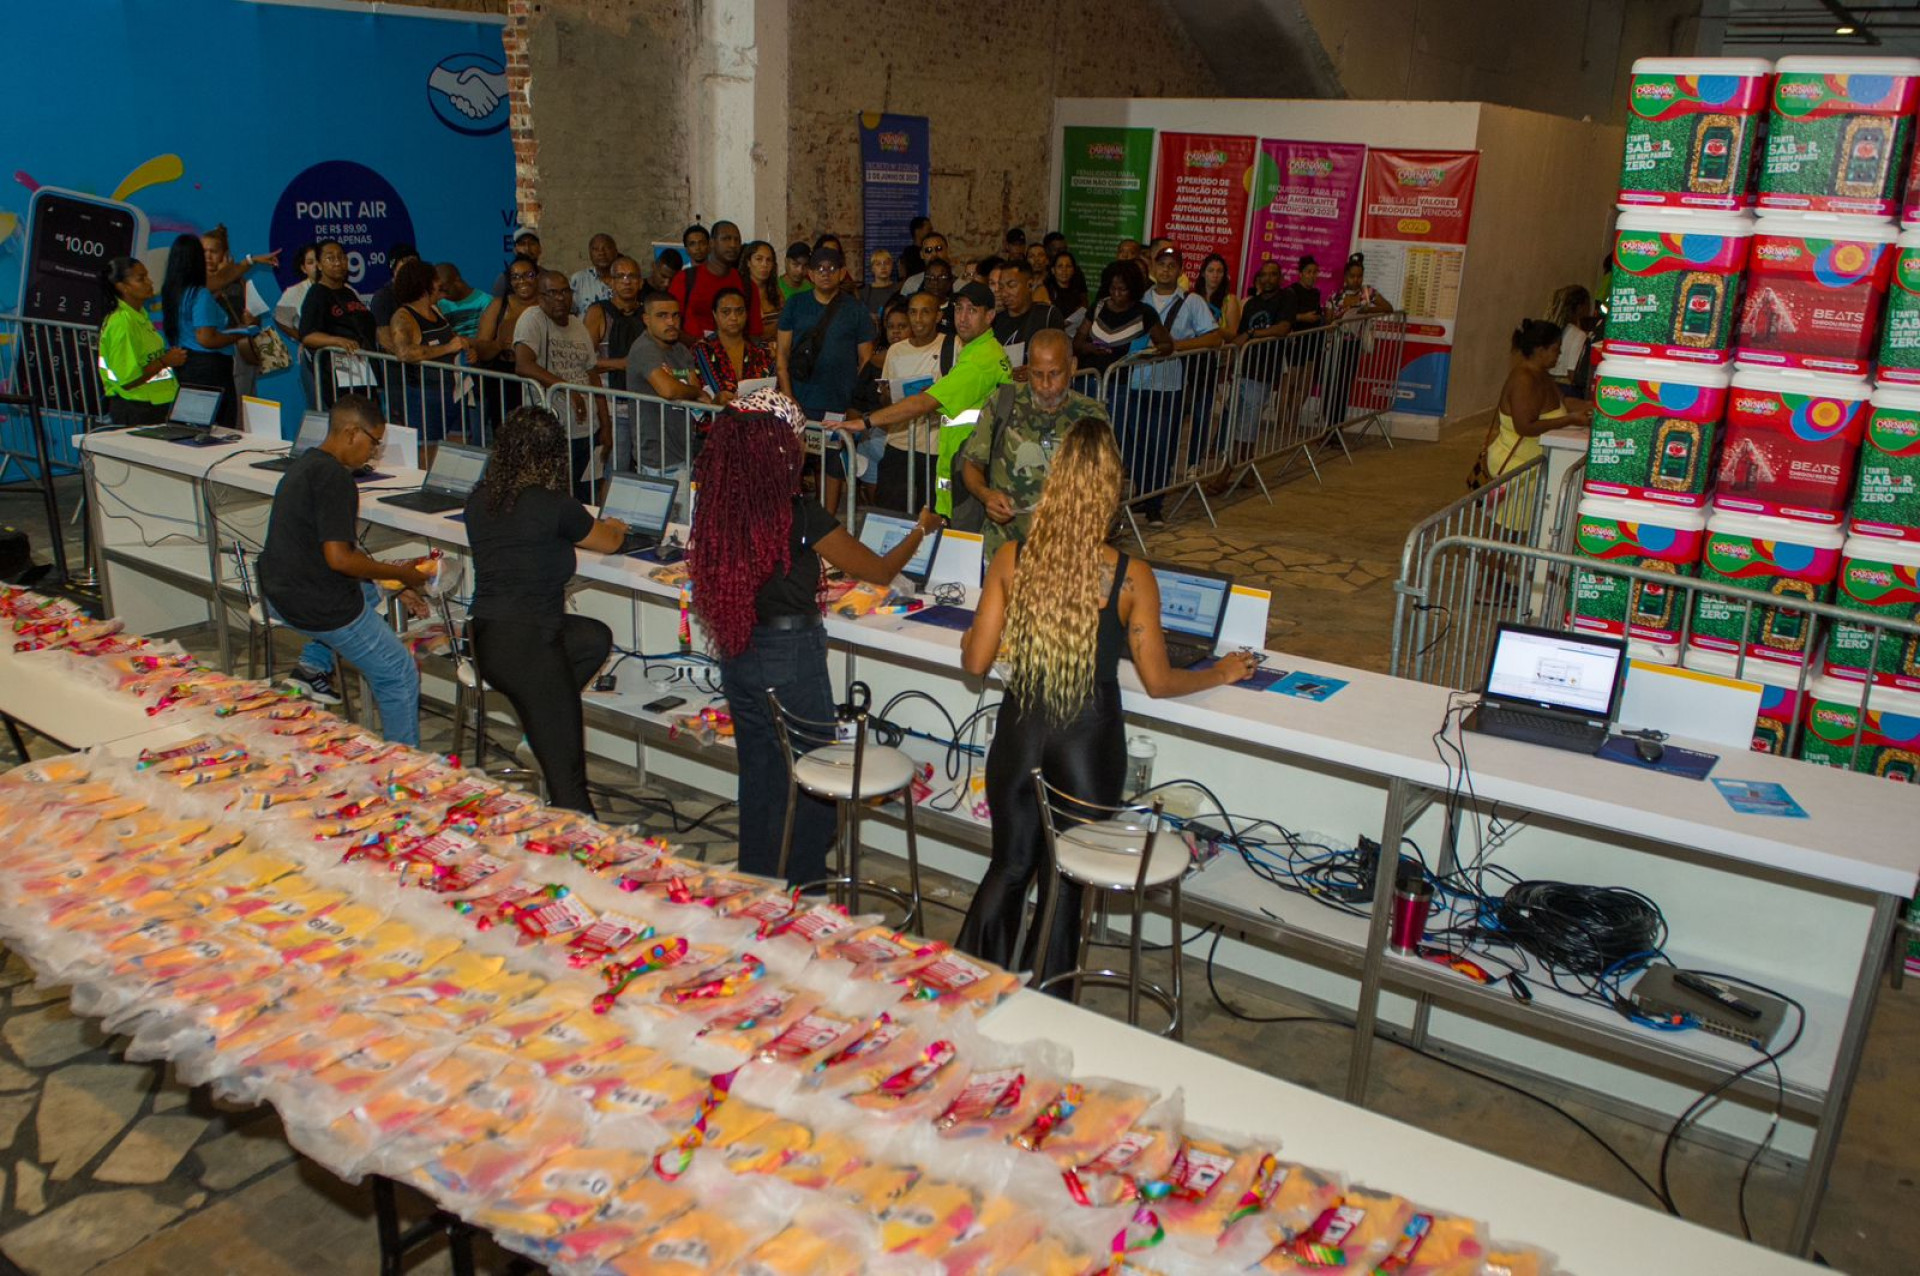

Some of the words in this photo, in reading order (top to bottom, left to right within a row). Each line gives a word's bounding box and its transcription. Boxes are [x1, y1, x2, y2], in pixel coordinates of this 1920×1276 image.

[1625, 159, 1656, 171] ZERO
[1767, 162, 1800, 173] ZERO
[1398, 167, 1441, 180] CARNAVAL
[1184, 175, 1218, 186] PERÍODO
[1176, 185, 1210, 196] ATUAÇÃO
[1212, 188, 1229, 196] DOS
[1268, 184, 1309, 194] REQUISITOS
[1310, 187, 1330, 196] PARA
[1332, 189, 1346, 198] SER
[1176, 195, 1226, 205] AMBULANTES
[1289, 196, 1335, 206] AMBULANTE
[1419, 197, 1456, 206] VALORES
[296, 201, 353, 219] POINT
[358, 201, 387, 218] AIR
[1173, 204, 1221, 214] AUTÔNOMOS
[1271, 204, 1315, 214] AUTÔNOMO
[1377, 206, 1420, 215] PRODUTOS
[1423, 208, 1463, 218] VENDIDOS
[1171, 214, 1215, 224] TRABALHAR
[315, 225, 328, 234] DE
[330, 224, 342, 234] R$
[1165, 222, 1204, 232] CARNAVAL
[1217, 226, 1232, 235] RUA
[337, 235, 372, 244] APENAS
[1177, 233, 1215, 242] RESTRINGE
[1217, 236, 1229, 244] AO
[65, 236, 104, 257] 10,00
[1180, 242, 1213, 252] HORÁRIO
[1757, 244, 1799, 256] CARNAVAL
[59, 296, 66, 307] 2
[83, 301, 91, 312] 3
[1611, 312, 1641, 323] ZERO
[1813, 308, 1865, 322] BEATS
[1736, 398, 1776, 412] CARNAVAL
[1876, 419, 1918, 430] CARNAVAL
[1591, 455, 1621, 464] ZERO
[1791, 460, 1841, 475] BEATS
[1861, 493, 1896, 503] ZERO
[1578, 590, 1600, 599] ERO
[1700, 610, 1730, 621] ZERO
[1837, 638, 1870, 650] ZERO
